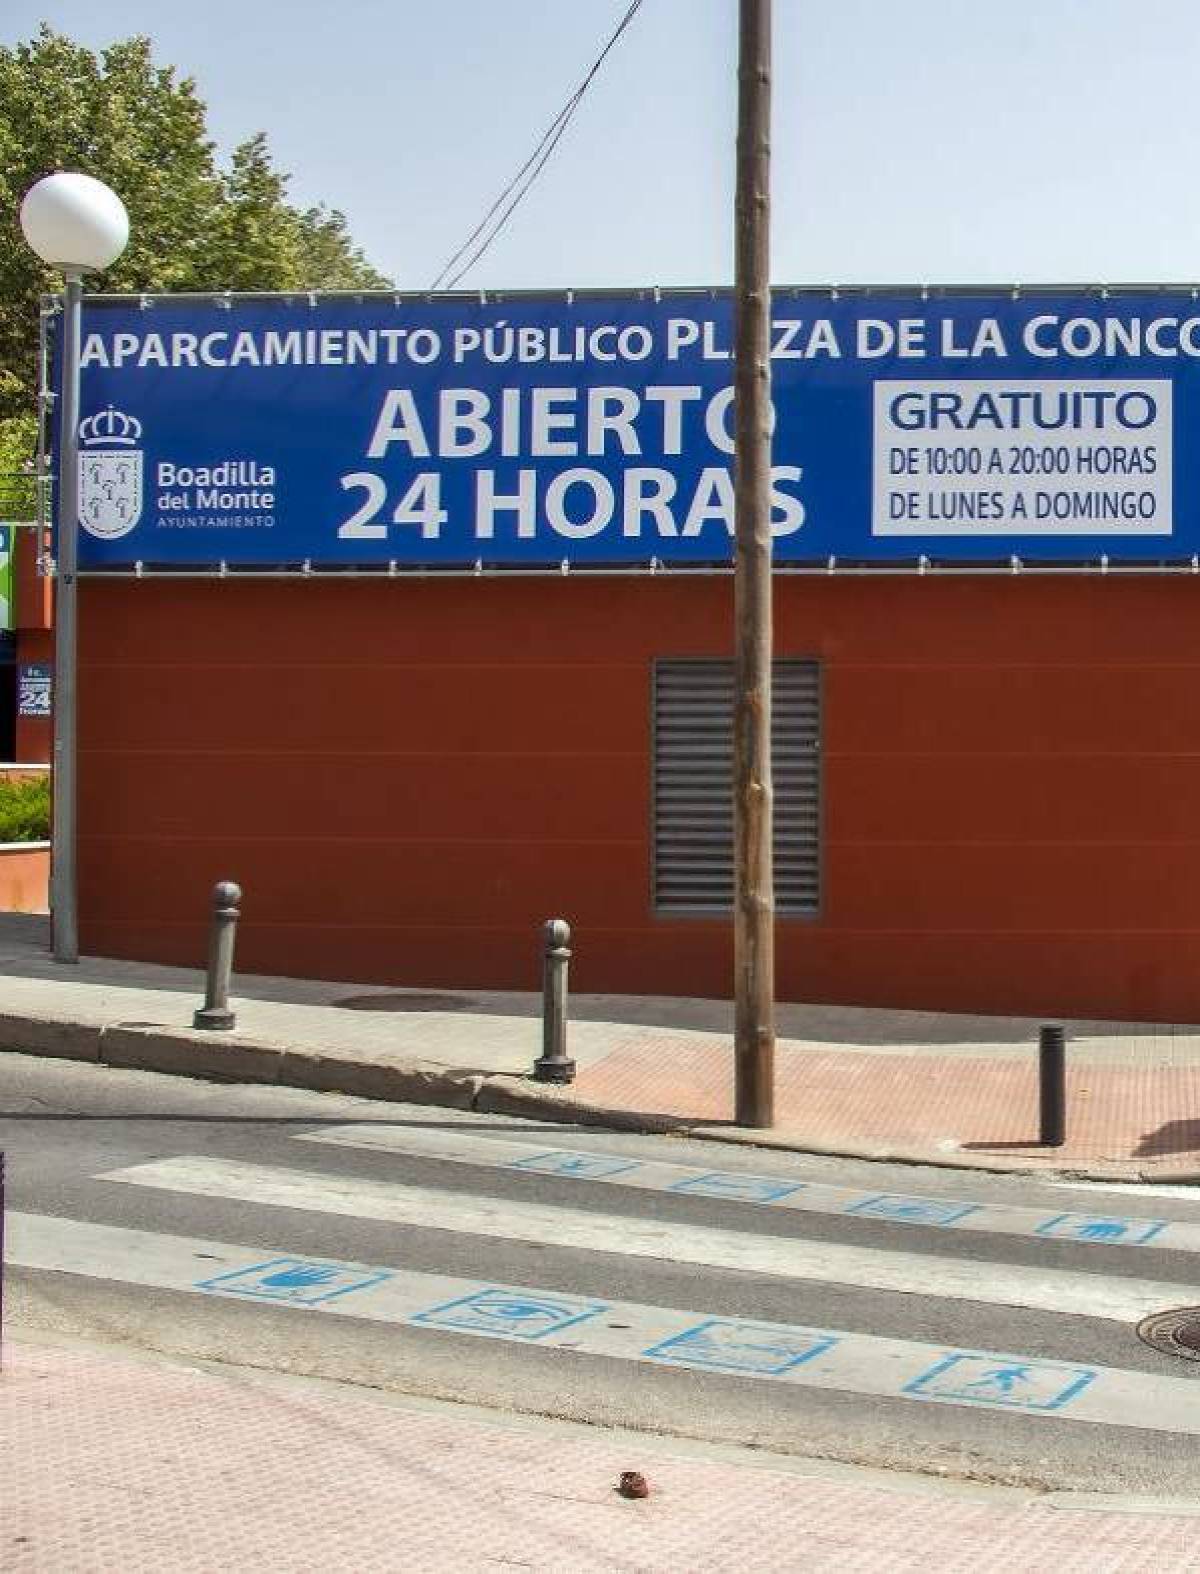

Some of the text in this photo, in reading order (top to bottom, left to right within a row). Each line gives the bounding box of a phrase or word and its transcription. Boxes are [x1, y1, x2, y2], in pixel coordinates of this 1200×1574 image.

[80, 329, 441, 368] APARCAMIENTO
[453, 319, 653, 363] PÚBLICO
[667, 318, 842, 361] PLZA
[857, 319, 925, 359] DE
[941, 319, 1007, 358] LA
[889, 391, 1157, 431] GRATUITO
[158, 461, 275, 487] Boadilla
[889, 446, 1157, 475] DE 10:00 A 20:00 HORAS
[158, 489, 276, 510] del Monte
[337, 466, 806, 539] 24 HORAS
[889, 491, 1157, 520] DE LUNES A DOMINGO
